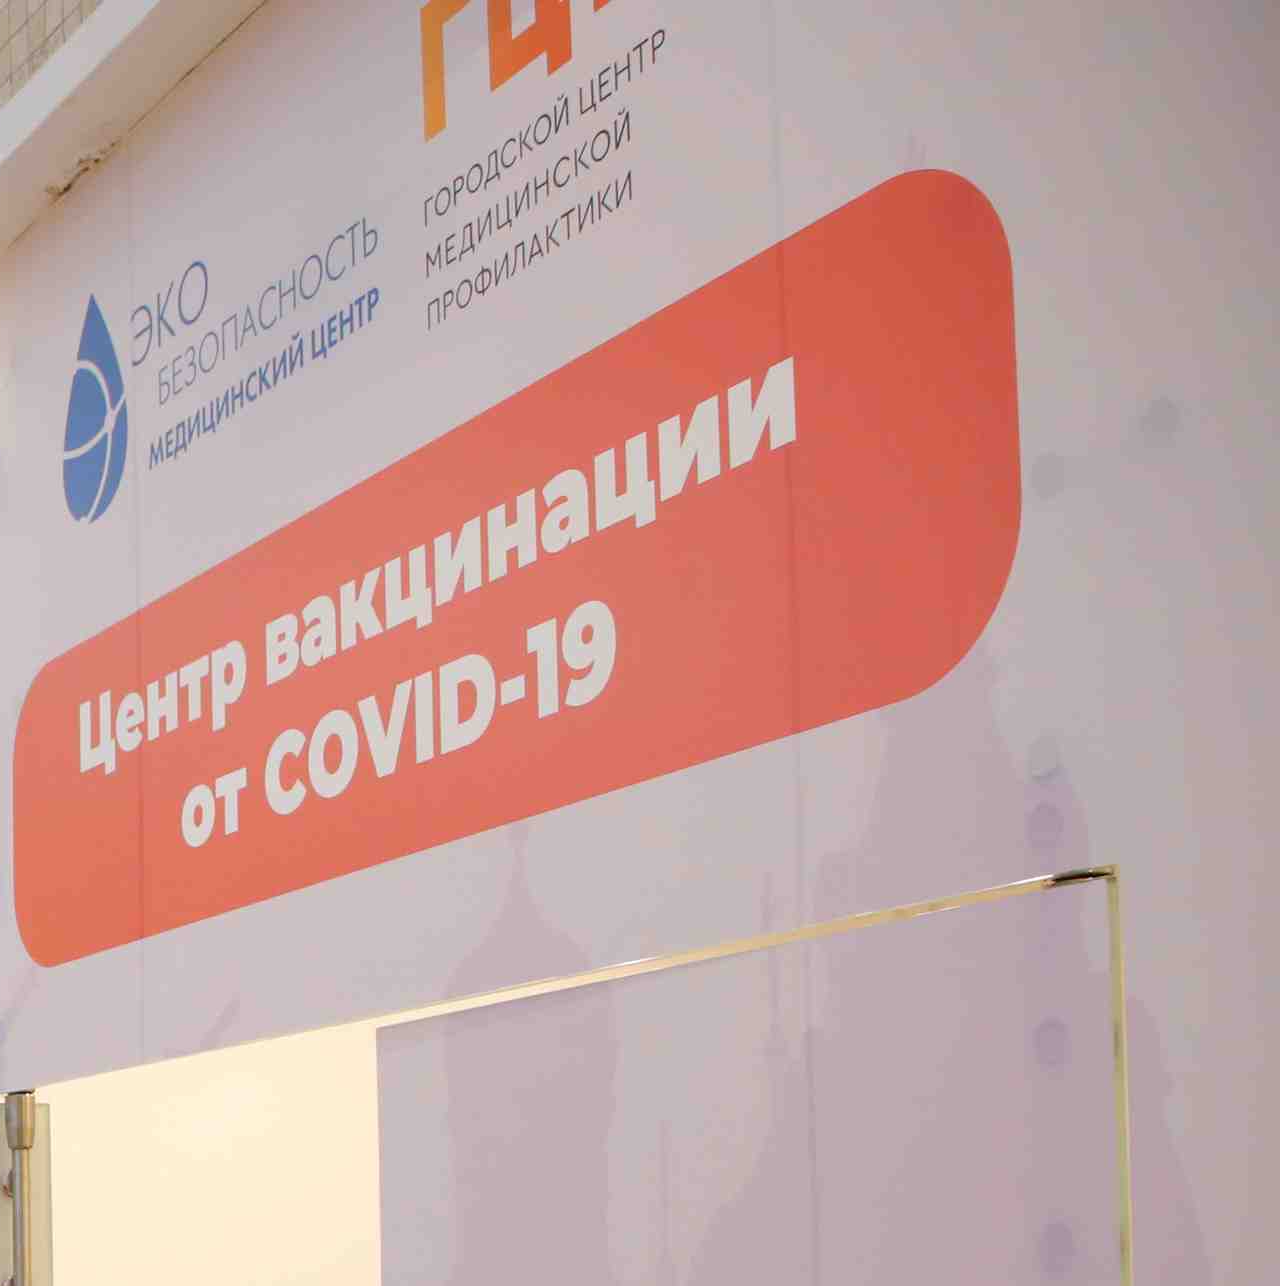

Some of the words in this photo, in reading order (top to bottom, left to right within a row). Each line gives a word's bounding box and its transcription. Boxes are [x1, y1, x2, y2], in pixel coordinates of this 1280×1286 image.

[423, 93, 570, 228] ГОРОДСКОЙ
[578, 29, 666, 115] ЦЕНТР
[425, 107, 631, 279] МЕДИЦИНСКОЙ
[130, 261, 209, 367] ЭКО
[158, 217, 378, 405] БЕЗОПАСНОСТЬ
[426, 170, 633, 331] ПРОФИЛАКТИКИ
[148, 331, 304, 470] МЕДИЦИНСКИЙ
[311, 287, 380, 360] ЦЕНТР
[78, 640, 247, 776] Центр
[264, 355, 797, 686] вакцинации
[181, 766, 247, 848] от
[263, 600, 617, 816] COVID-19
